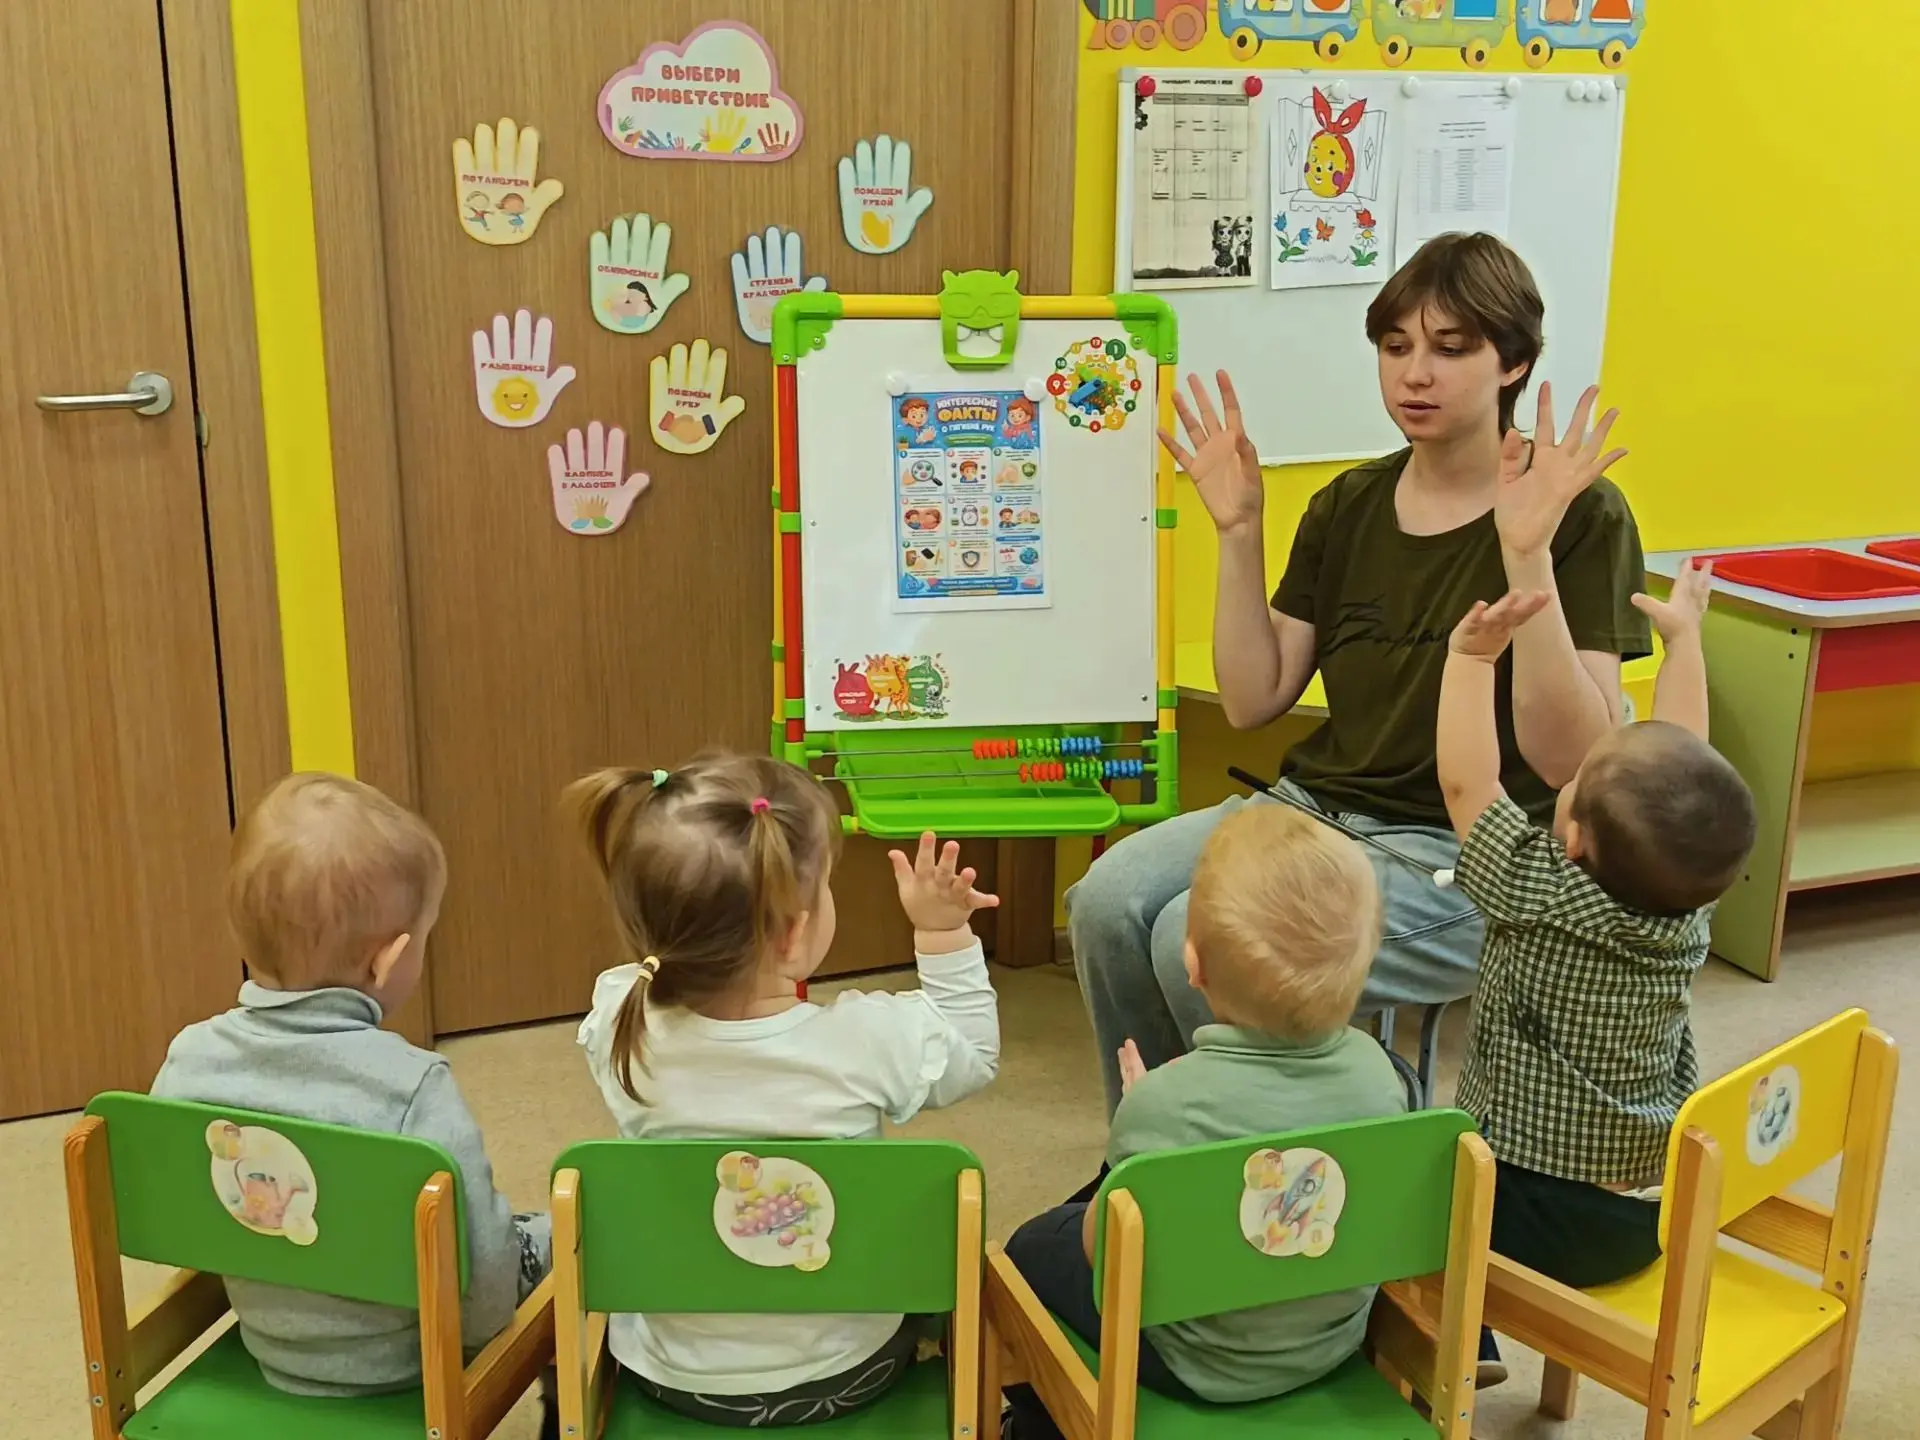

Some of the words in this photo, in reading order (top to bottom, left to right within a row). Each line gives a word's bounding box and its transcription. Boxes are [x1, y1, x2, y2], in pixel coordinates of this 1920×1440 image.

[661, 64, 741, 83] ВЫБЕРИ
[631, 86, 770, 108] ПРИВЕТСТВИЕ
[462, 174, 530, 187] ПОТАНЦУЕМ
[854, 187, 903, 196] ПОМАШЕМ
[862, 197, 894, 206] РУКОЙ
[750, 277, 794, 287] СТУКНЕМ
[1052, 379, 1061, 391] 9
[936, 397, 998, 409] ИНТЕРЕСНЫЕ
[938, 406, 997, 421] ФАКТЫ
[1111, 415, 1119, 425] 5
[941, 425, 949, 433] О
[981, 423, 996, 432] РУК
[570, 481, 617, 489] ЛАДОШИ
